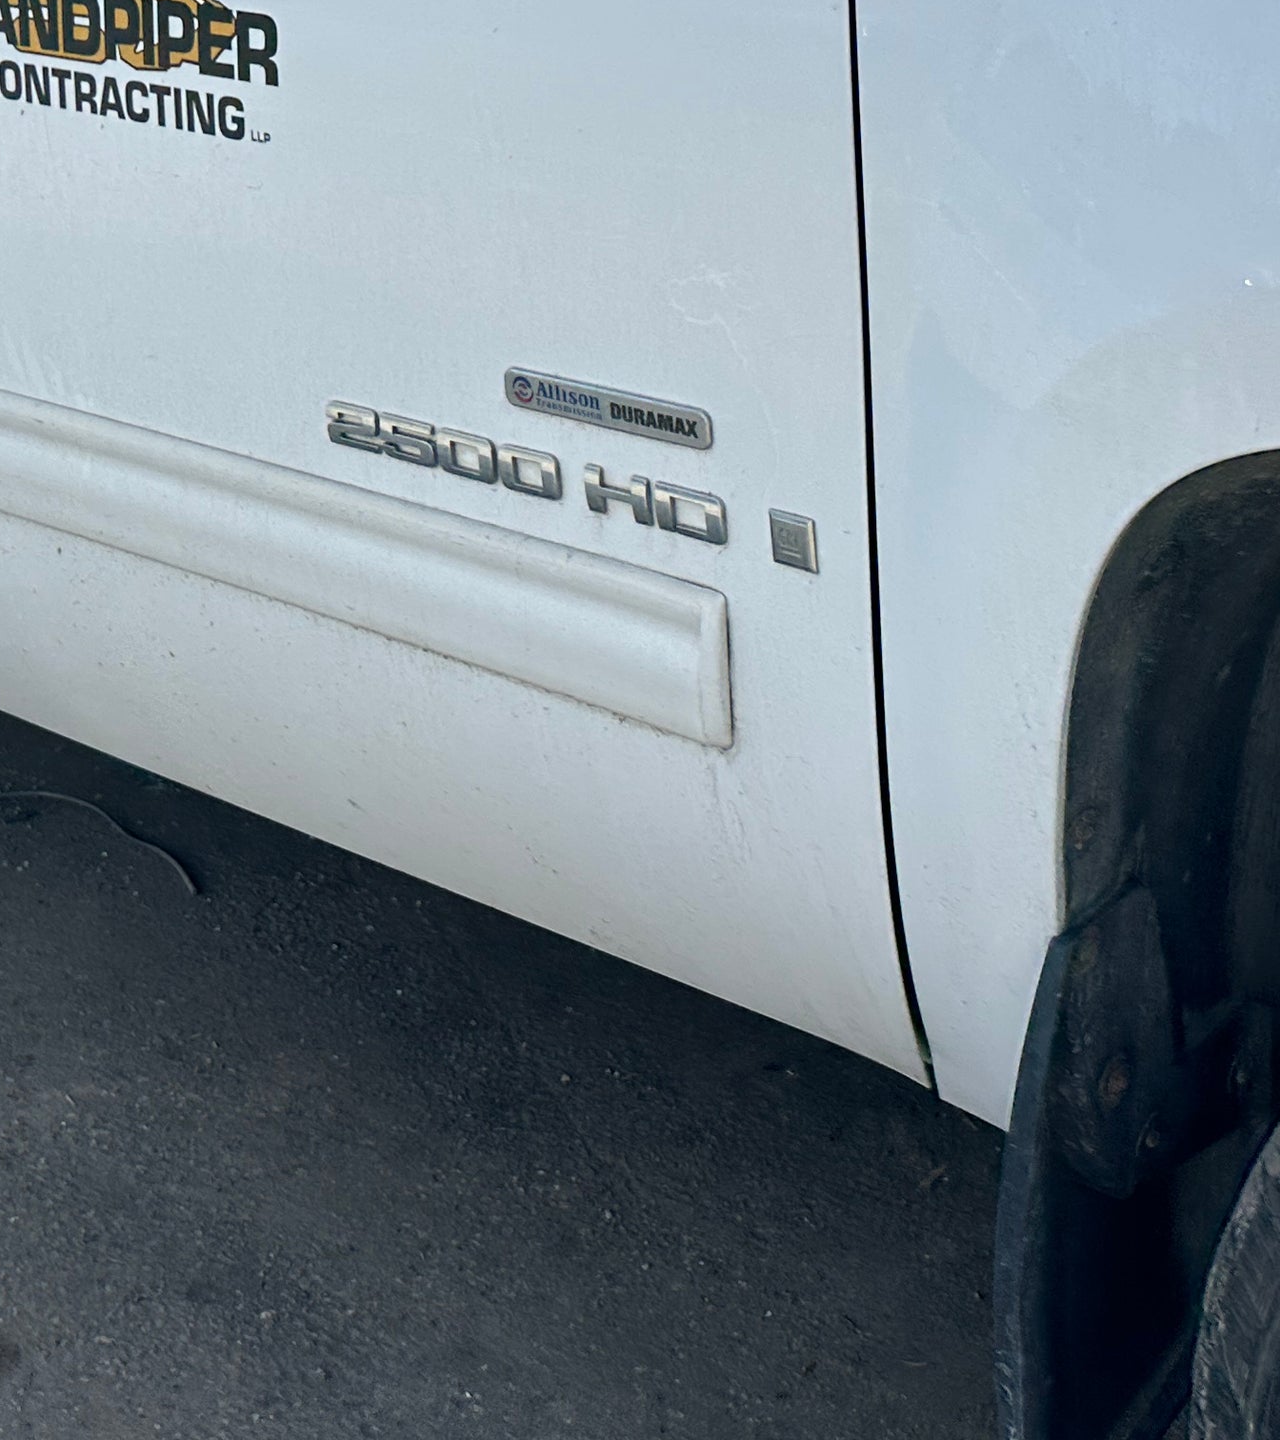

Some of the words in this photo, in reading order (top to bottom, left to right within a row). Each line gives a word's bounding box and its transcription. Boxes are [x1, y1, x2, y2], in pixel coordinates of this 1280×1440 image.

[250, 129, 271, 143] LLP
[535, 381, 601, 410] Allison
[609, 401, 699, 439] DURAMAX
[325, 399, 563, 501] 2500
[584, 462, 729, 546] HD
